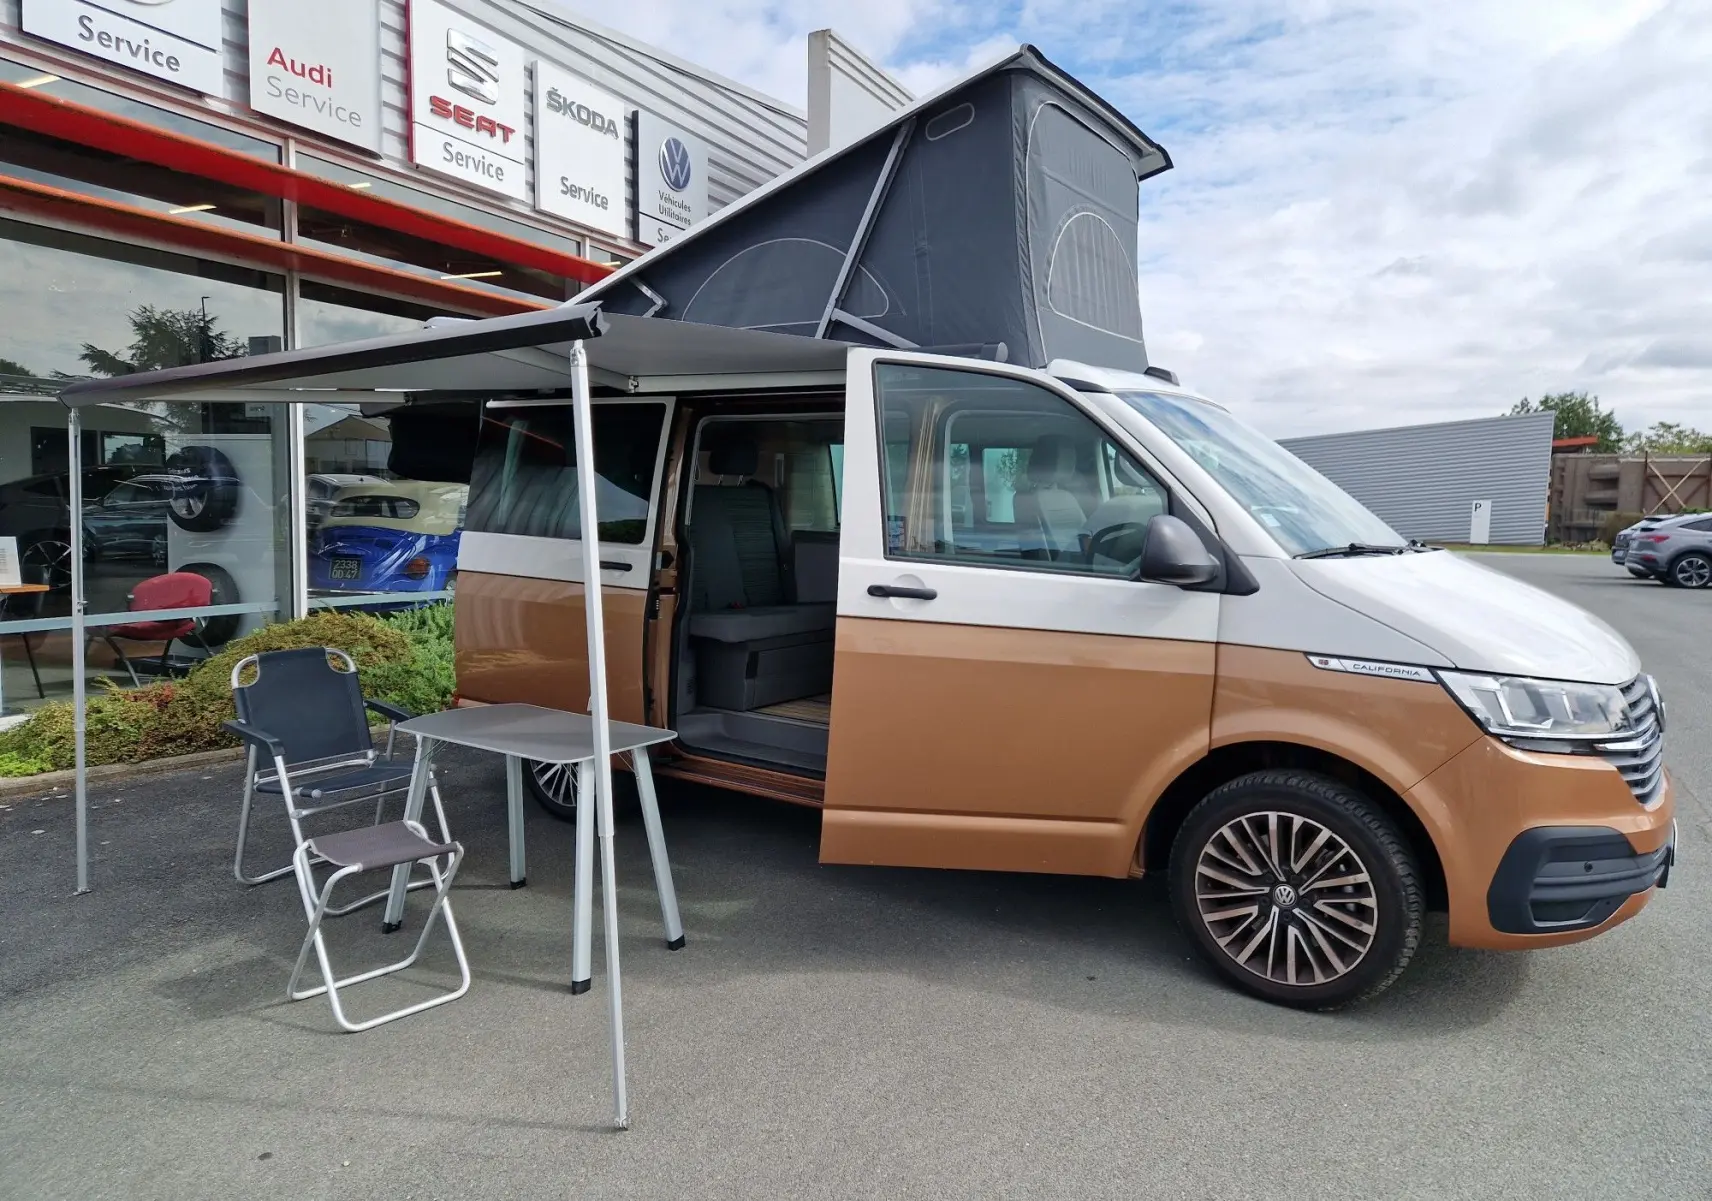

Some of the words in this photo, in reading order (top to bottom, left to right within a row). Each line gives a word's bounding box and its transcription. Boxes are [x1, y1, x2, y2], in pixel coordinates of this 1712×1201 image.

[77, 14, 182, 73] Service
[267, 47, 333, 88] Audi
[266, 75, 362, 127] Service
[546, 86, 619, 140] ŠKODA
[429, 95, 516, 144] SEAT
[442, 141, 504, 182] Service
[560, 176, 608, 211] Service
[658, 190, 691, 213] Véhicules
[658, 203, 691, 226] Utilitaires
[1474, 502, 1482, 512] P
[333, 559, 358, 570] 2338
[345, 569, 358, 579] 47
[1352, 663, 1421, 677] CALIFORNIA
